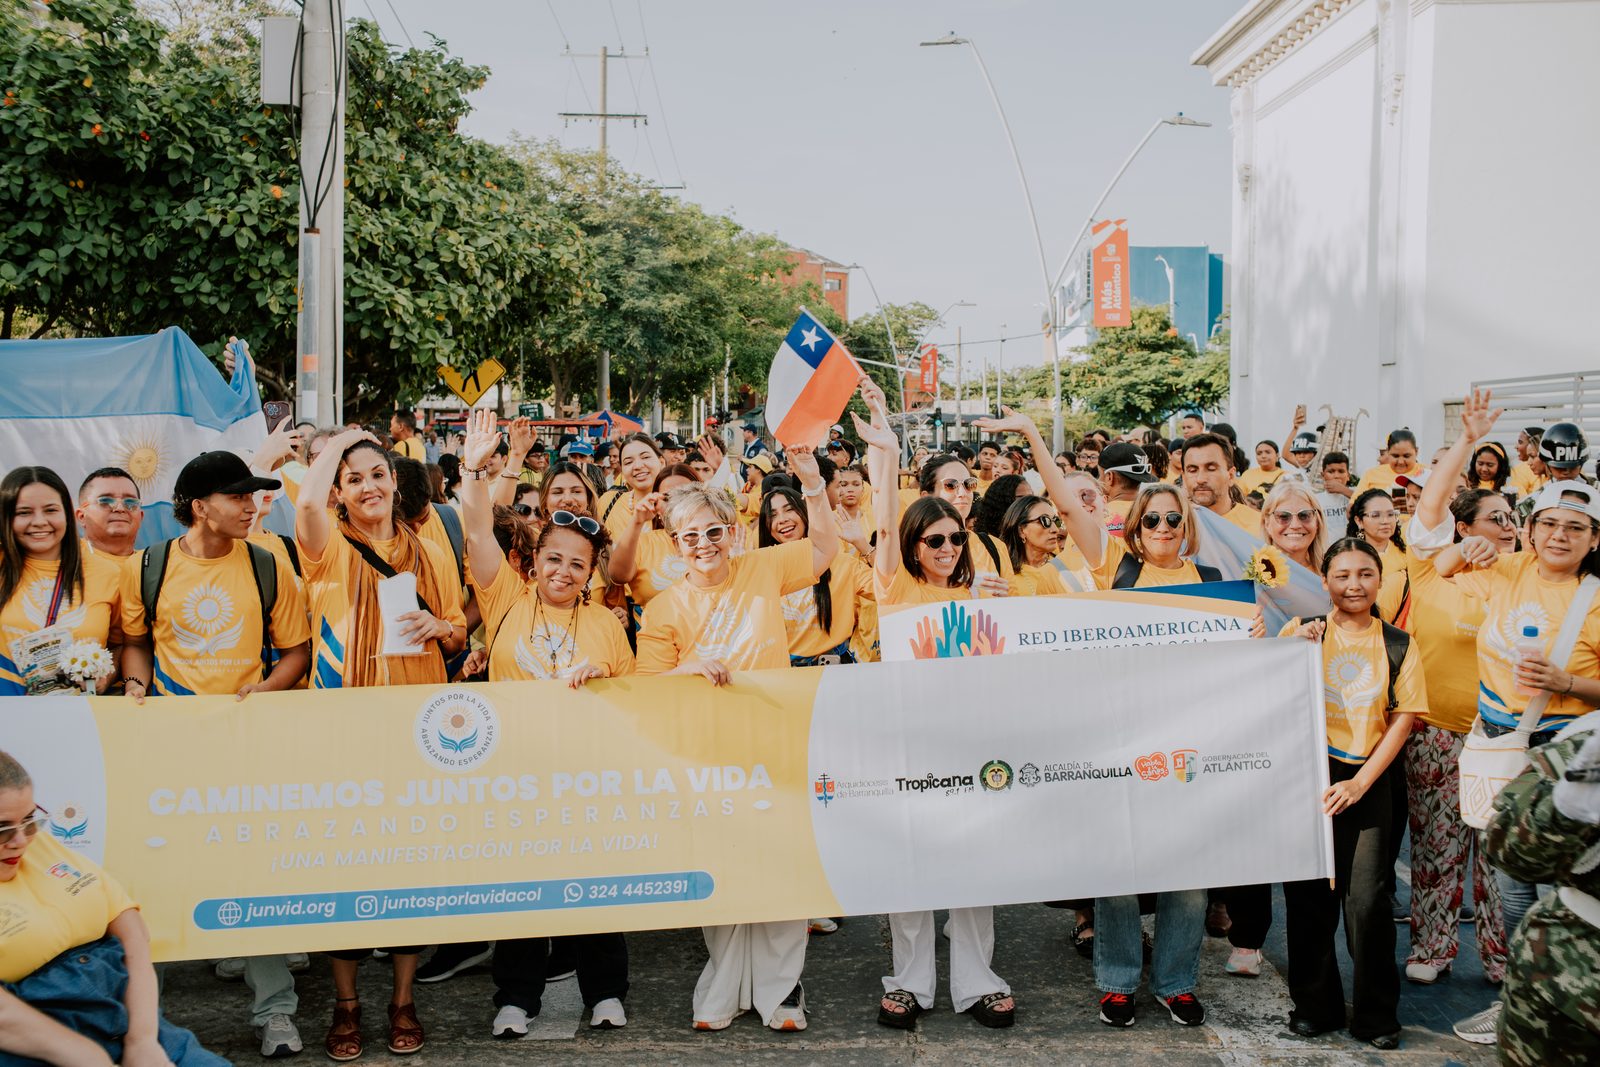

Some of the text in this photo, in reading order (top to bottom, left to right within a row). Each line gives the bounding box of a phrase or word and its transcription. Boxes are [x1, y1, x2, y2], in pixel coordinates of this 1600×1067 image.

[1101, 280, 1113, 309] Más
[1555, 446, 1578, 461] PM
[1018, 631, 1057, 646] RED
[1063, 617, 1242, 643] IBEROAMERICANA
[422, 693, 492, 724] JUNTOS POR LA VIDA
[421, 725, 494, 766] ABRAZANDO ESPERANZAS
[1202, 751, 1270, 763] GOBERNACIÓN DEL
[1044, 761, 1094, 772] ALCALDÍA DE
[1044, 766, 1133, 783] BARRANQUILLA
[1203, 758, 1272, 774] ATLÁNTICO
[148, 763, 773, 816] CAMINEMOS JUNTOS POR LA VIDA
[895, 773, 974, 793] Tropicana
[205, 798, 735, 844] ABRAZANDO ESPERANZAS
[270, 832, 661, 873] ¡UNA MANIFESTACIÓN POR LA VIDA!
[244, 879, 688, 922] junvid.org juntosporlavidacol 324 4452391
